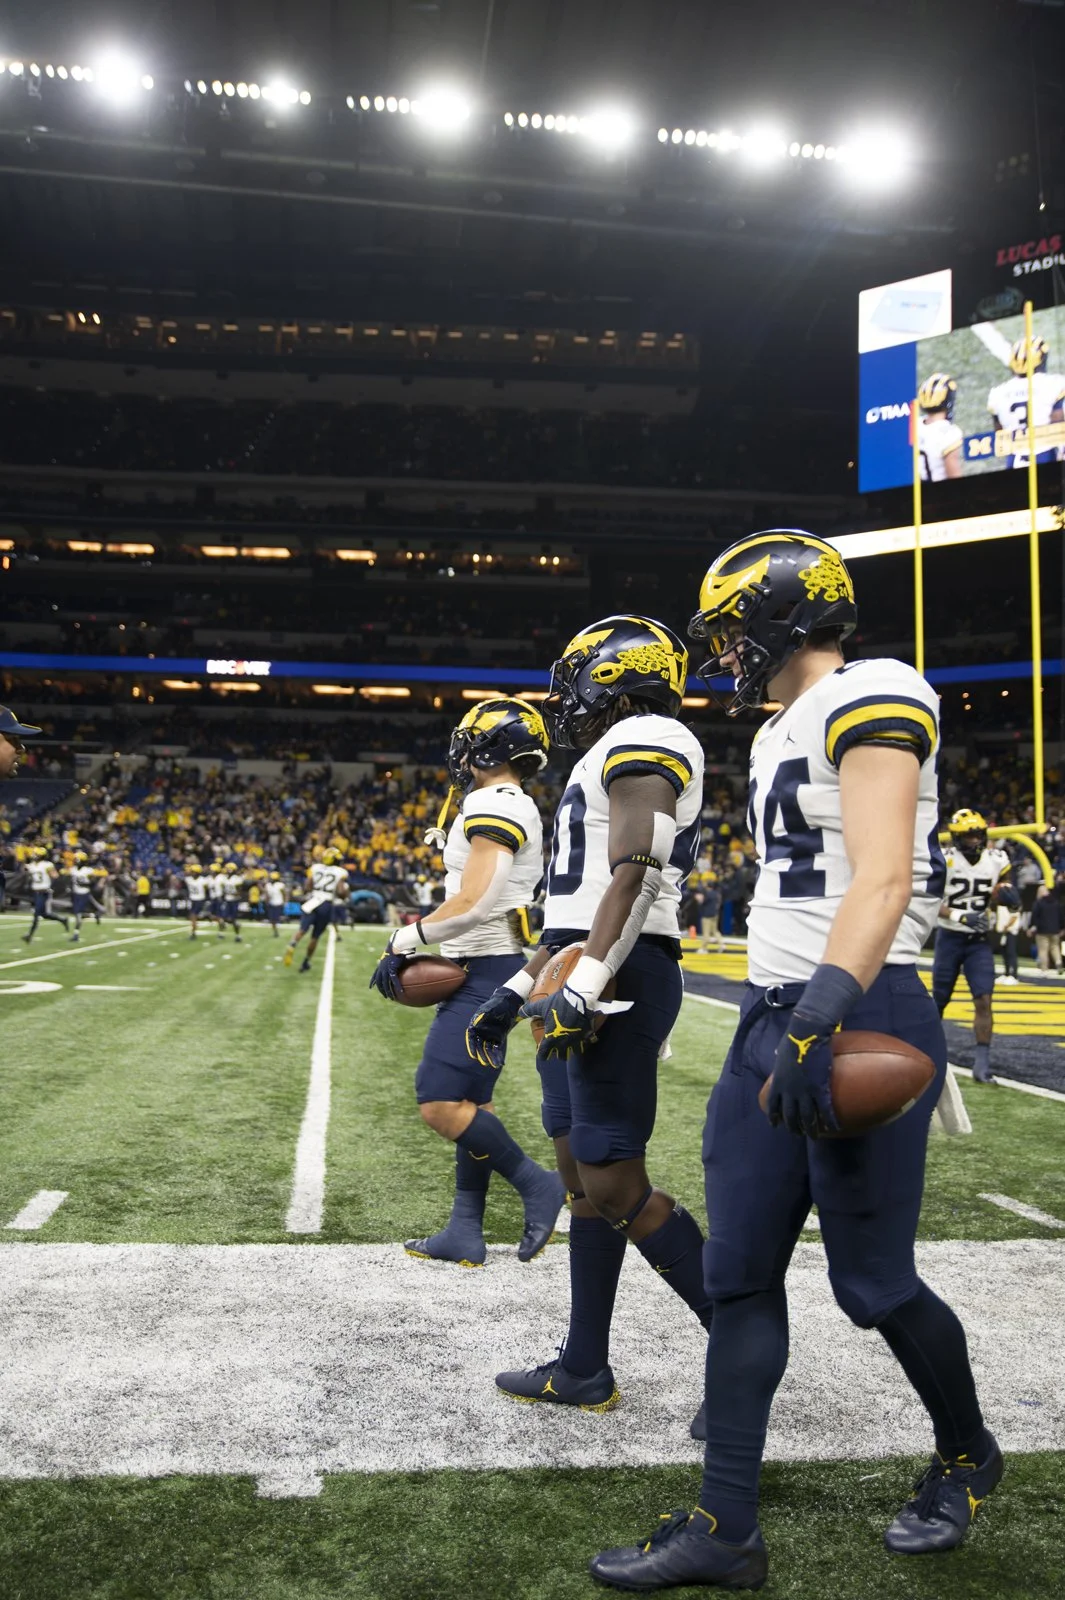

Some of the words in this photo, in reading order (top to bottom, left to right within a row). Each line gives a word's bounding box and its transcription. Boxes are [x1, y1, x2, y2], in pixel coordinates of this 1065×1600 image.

[996, 234, 1062, 267] LUCAS
[879, 402, 911, 420] TIAA
[312, 871, 335, 893] 22
[948, 878, 992, 910] 25
